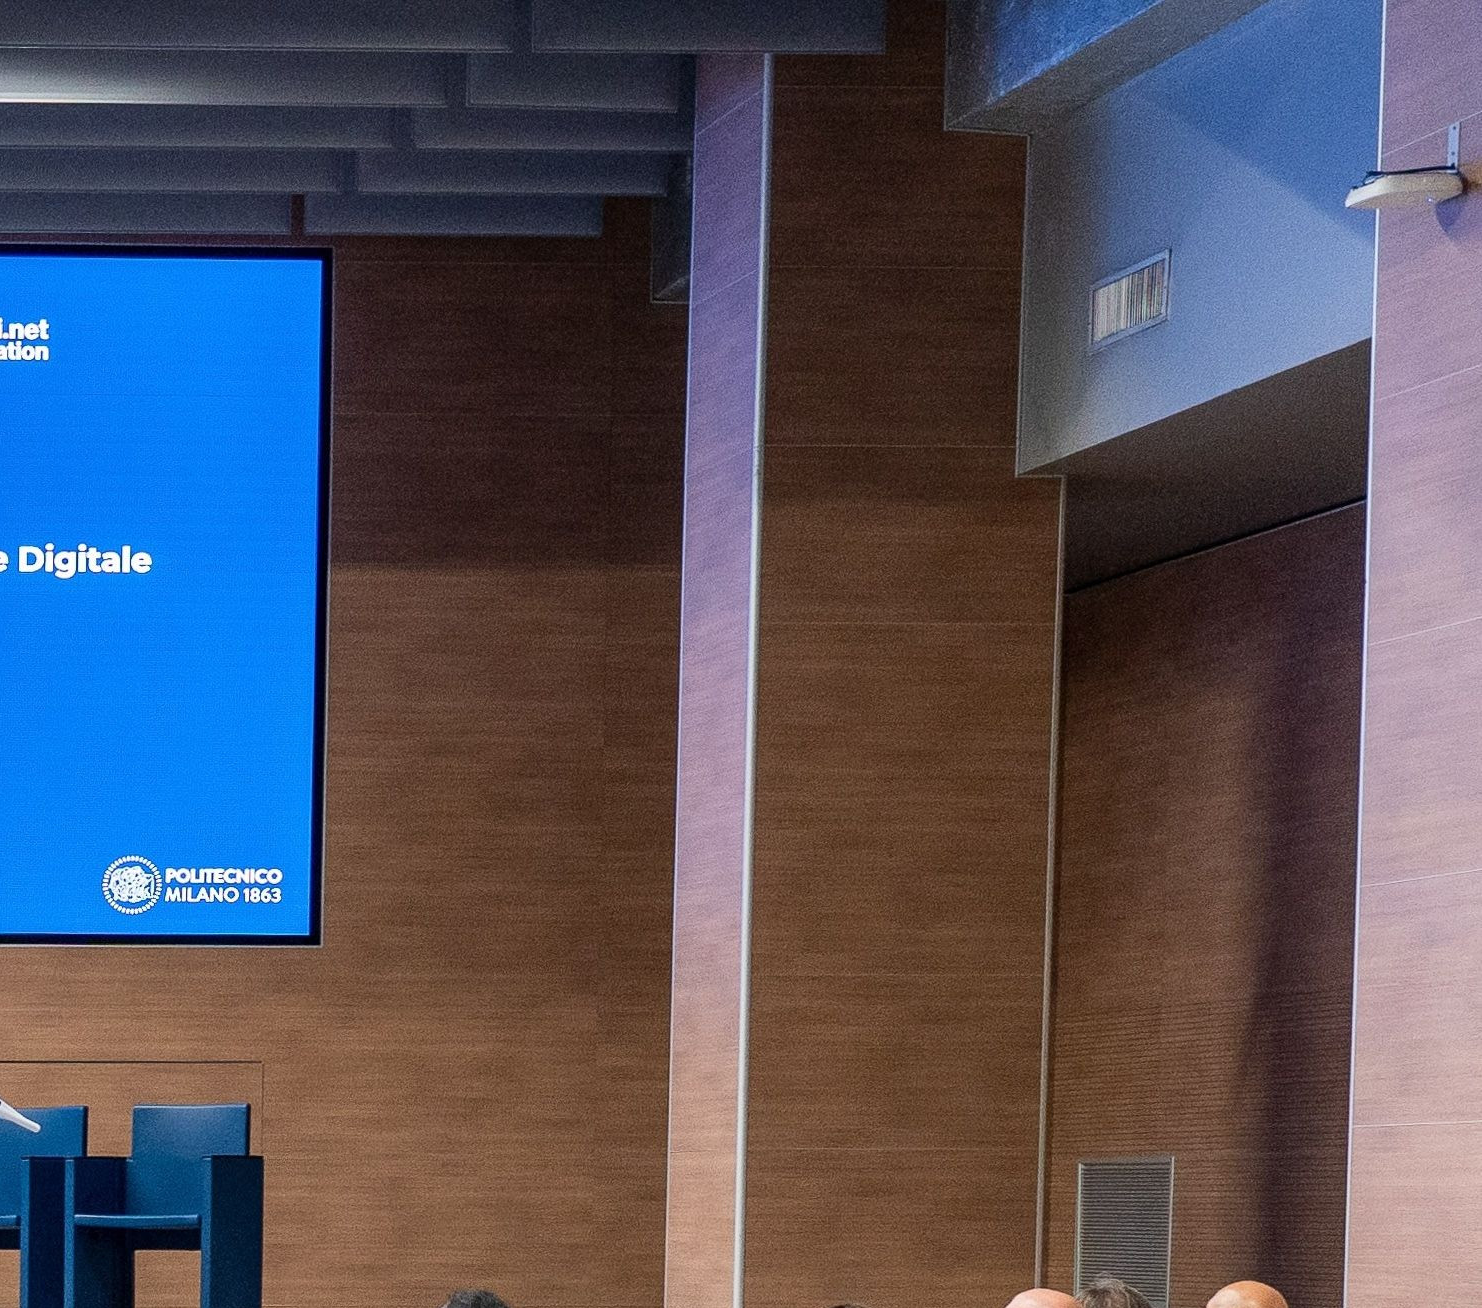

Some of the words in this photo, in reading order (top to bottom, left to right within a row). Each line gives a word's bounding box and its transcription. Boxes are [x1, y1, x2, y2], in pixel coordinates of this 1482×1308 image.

[18, 543, 153, 580] Digitale
[165, 868, 283, 885] POLITECNICO
[164, 887, 240, 903] MILANO
[243, 887, 282, 903] 1863
